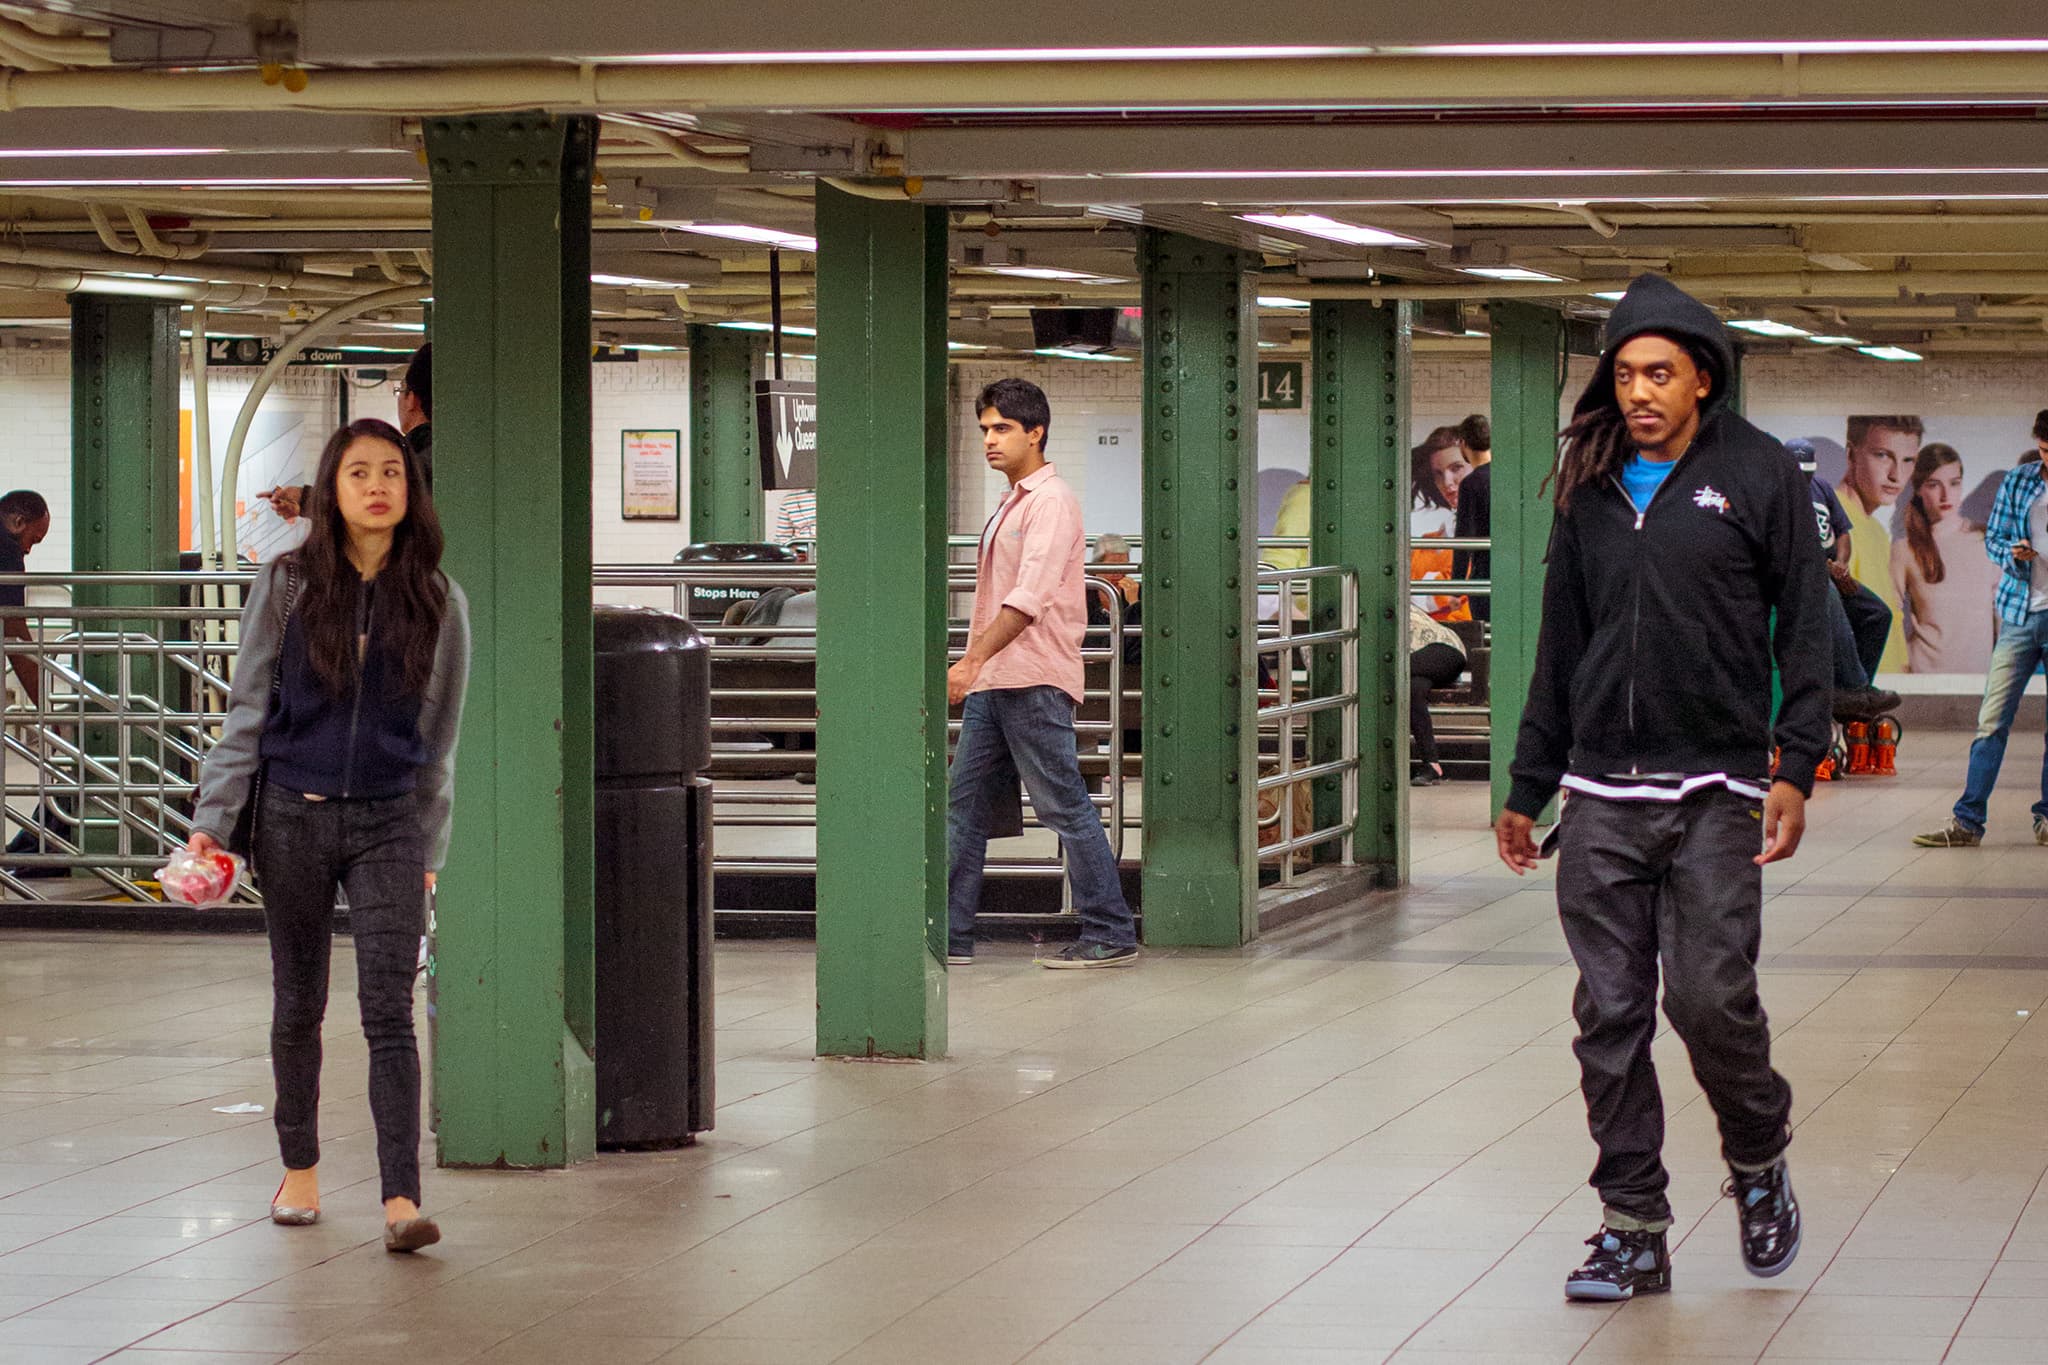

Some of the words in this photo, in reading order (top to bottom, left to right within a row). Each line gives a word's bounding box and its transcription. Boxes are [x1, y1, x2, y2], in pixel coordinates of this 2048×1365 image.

[262, 350, 270, 361] 2
[310, 350, 342, 361] down
[1260, 370, 1295, 401] 14
[693, 586, 728, 600] Stops
[729, 588, 760, 599] Here
